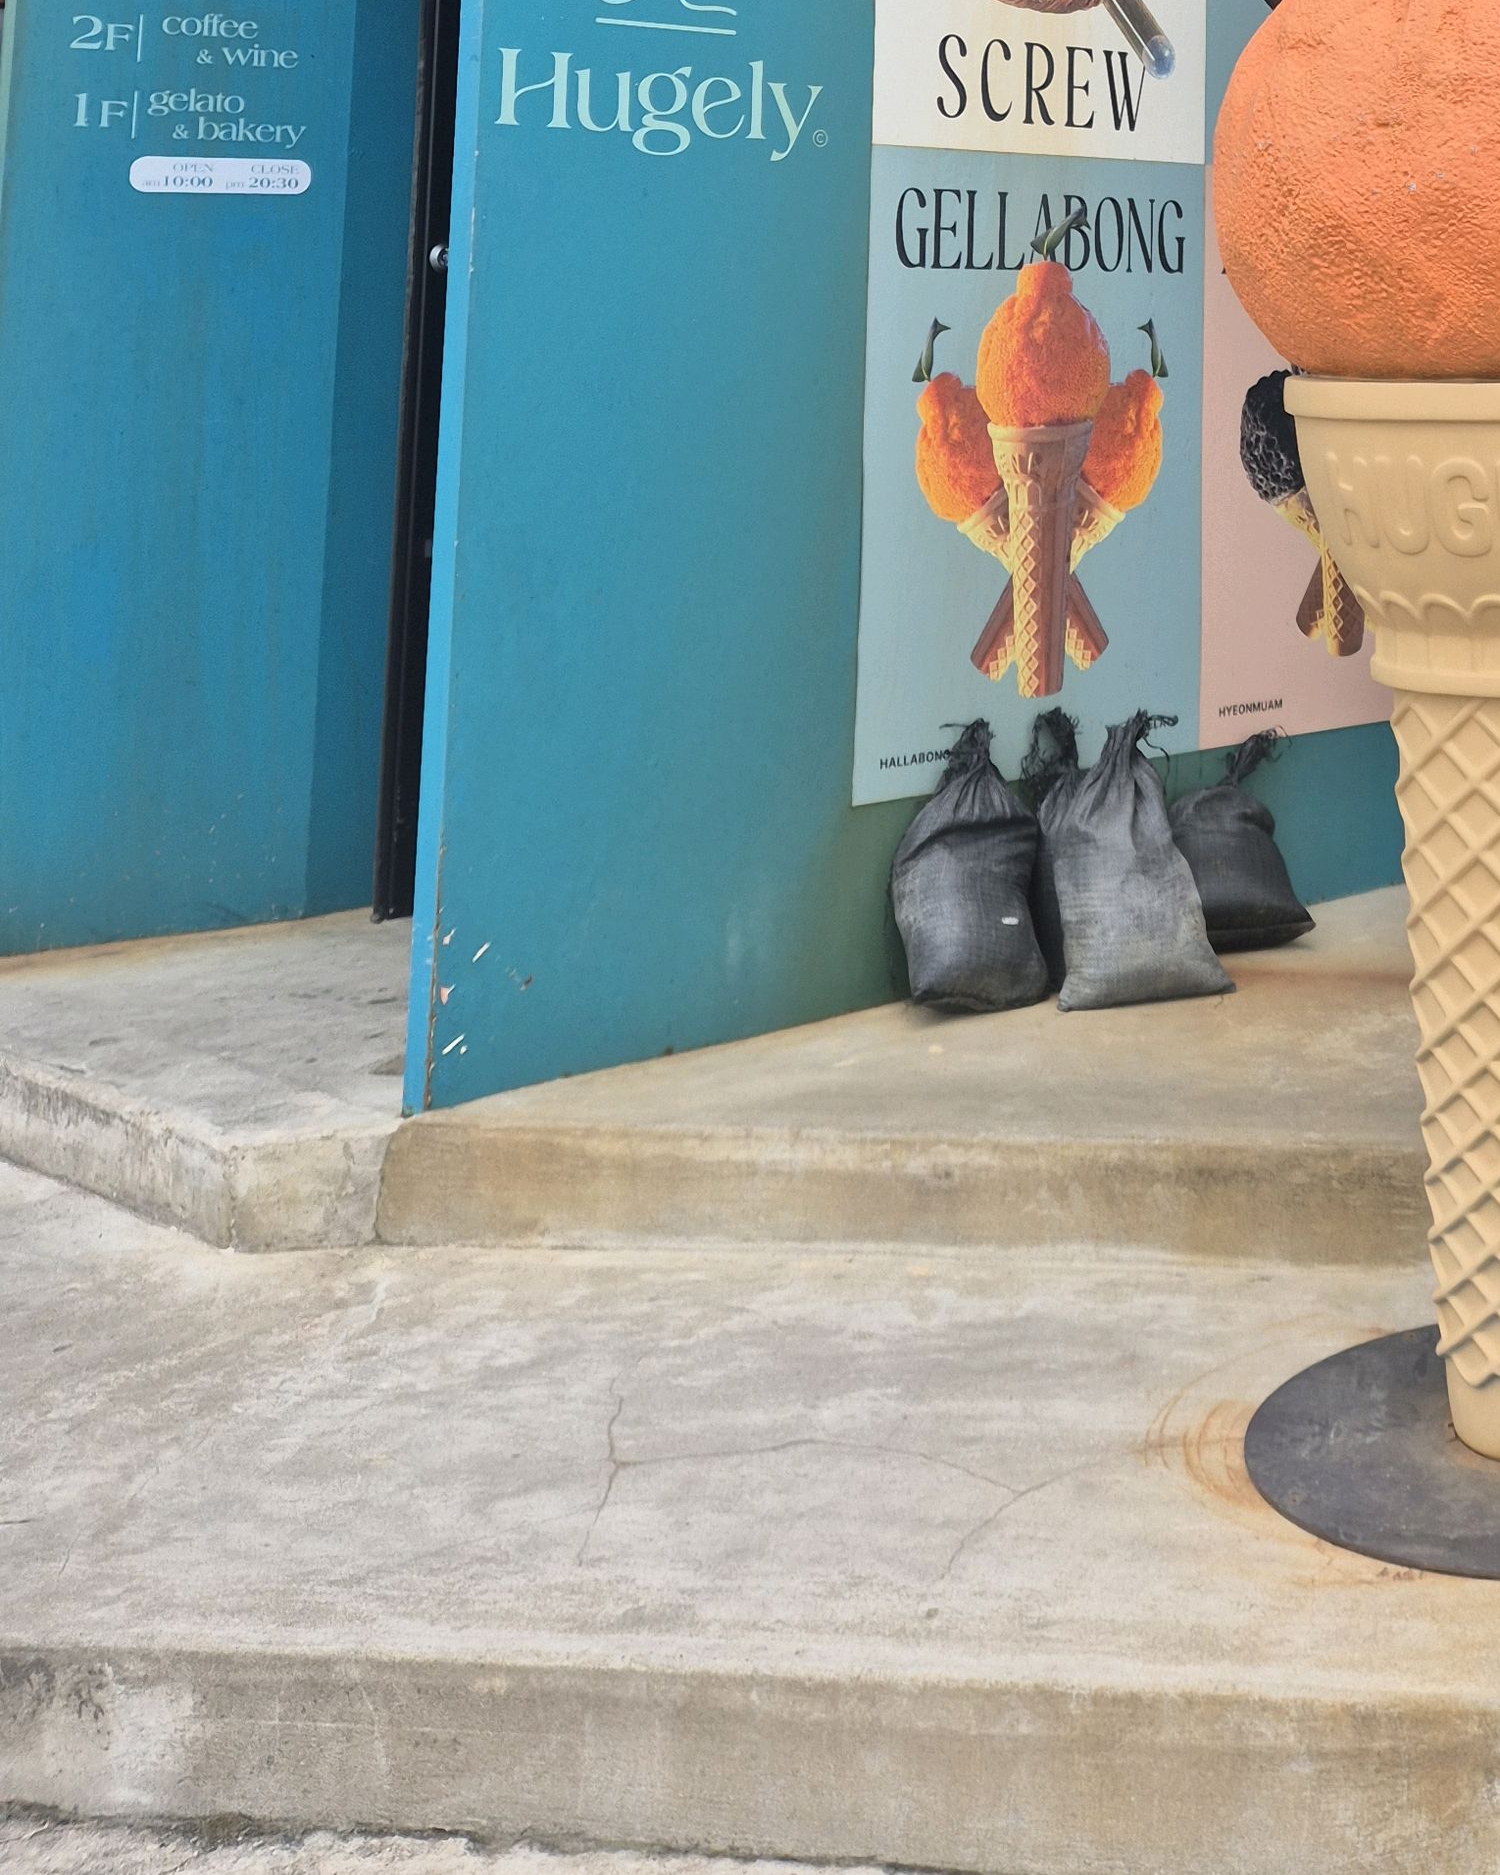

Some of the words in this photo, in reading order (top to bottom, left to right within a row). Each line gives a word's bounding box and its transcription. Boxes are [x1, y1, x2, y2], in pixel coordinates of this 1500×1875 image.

[69, 15, 133, 51] 2F
[162, 13, 258, 39] coffee
[196, 48, 214, 65] &
[222, 43, 299, 69] wine
[936, 33, 1146, 132] SCREW
[73, 92, 128, 128] 1F
[147, 88, 245, 116] gelato
[493, 47, 823, 162] Hugely
[172, 124, 189, 140] &
[197, 116, 307, 149] bakery
[163, 175, 213, 188] 10:00
[248, 177, 299, 190] 20:30
[172, 161, 214, 173] OPEN
[251, 164, 300, 175] CLOSE
[1218, 698, 1283, 718] HYEONMUAM
